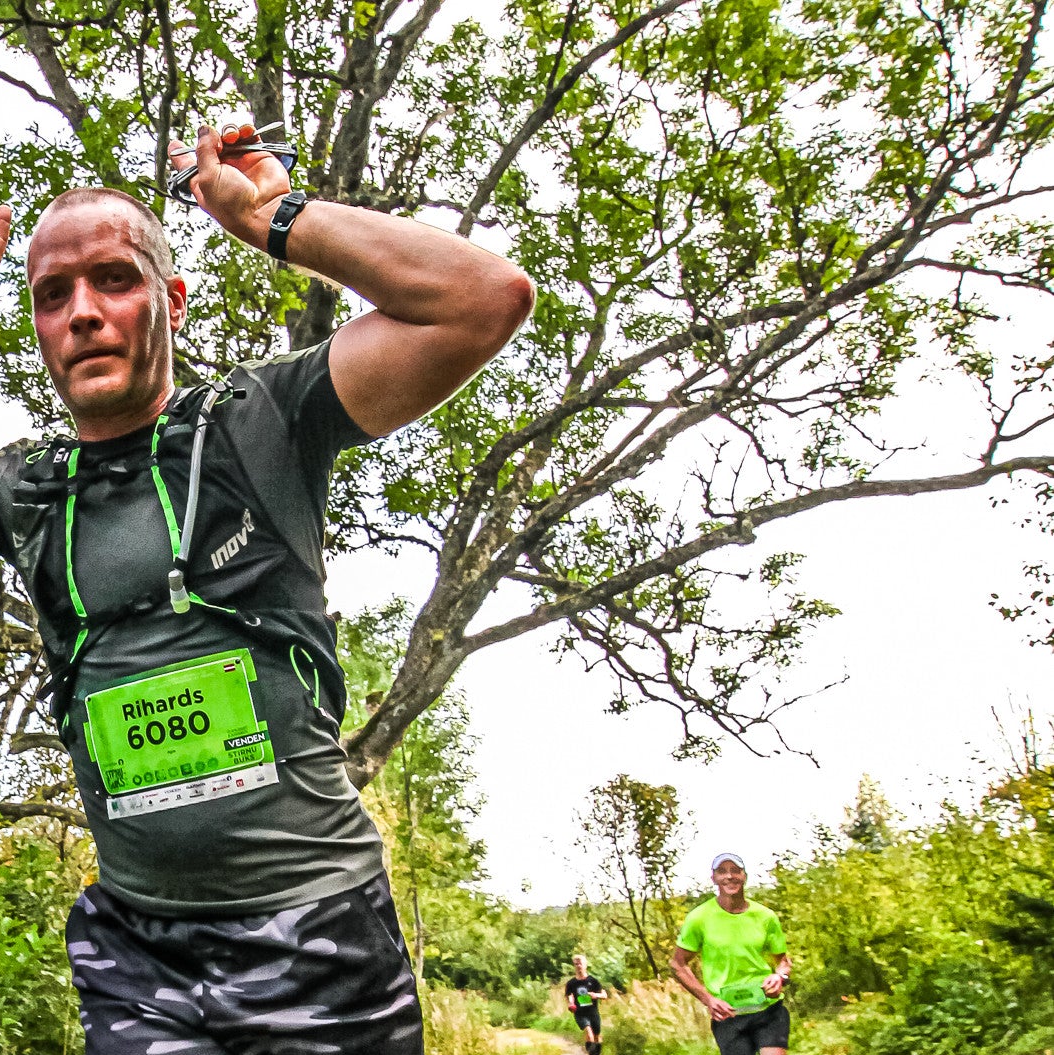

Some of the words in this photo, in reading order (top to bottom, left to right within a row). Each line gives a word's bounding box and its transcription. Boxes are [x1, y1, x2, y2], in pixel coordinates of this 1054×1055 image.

[122, 687, 205, 722] Rihards
[127, 710, 211, 750] 6080
[227, 732, 266, 748] VENDEN
